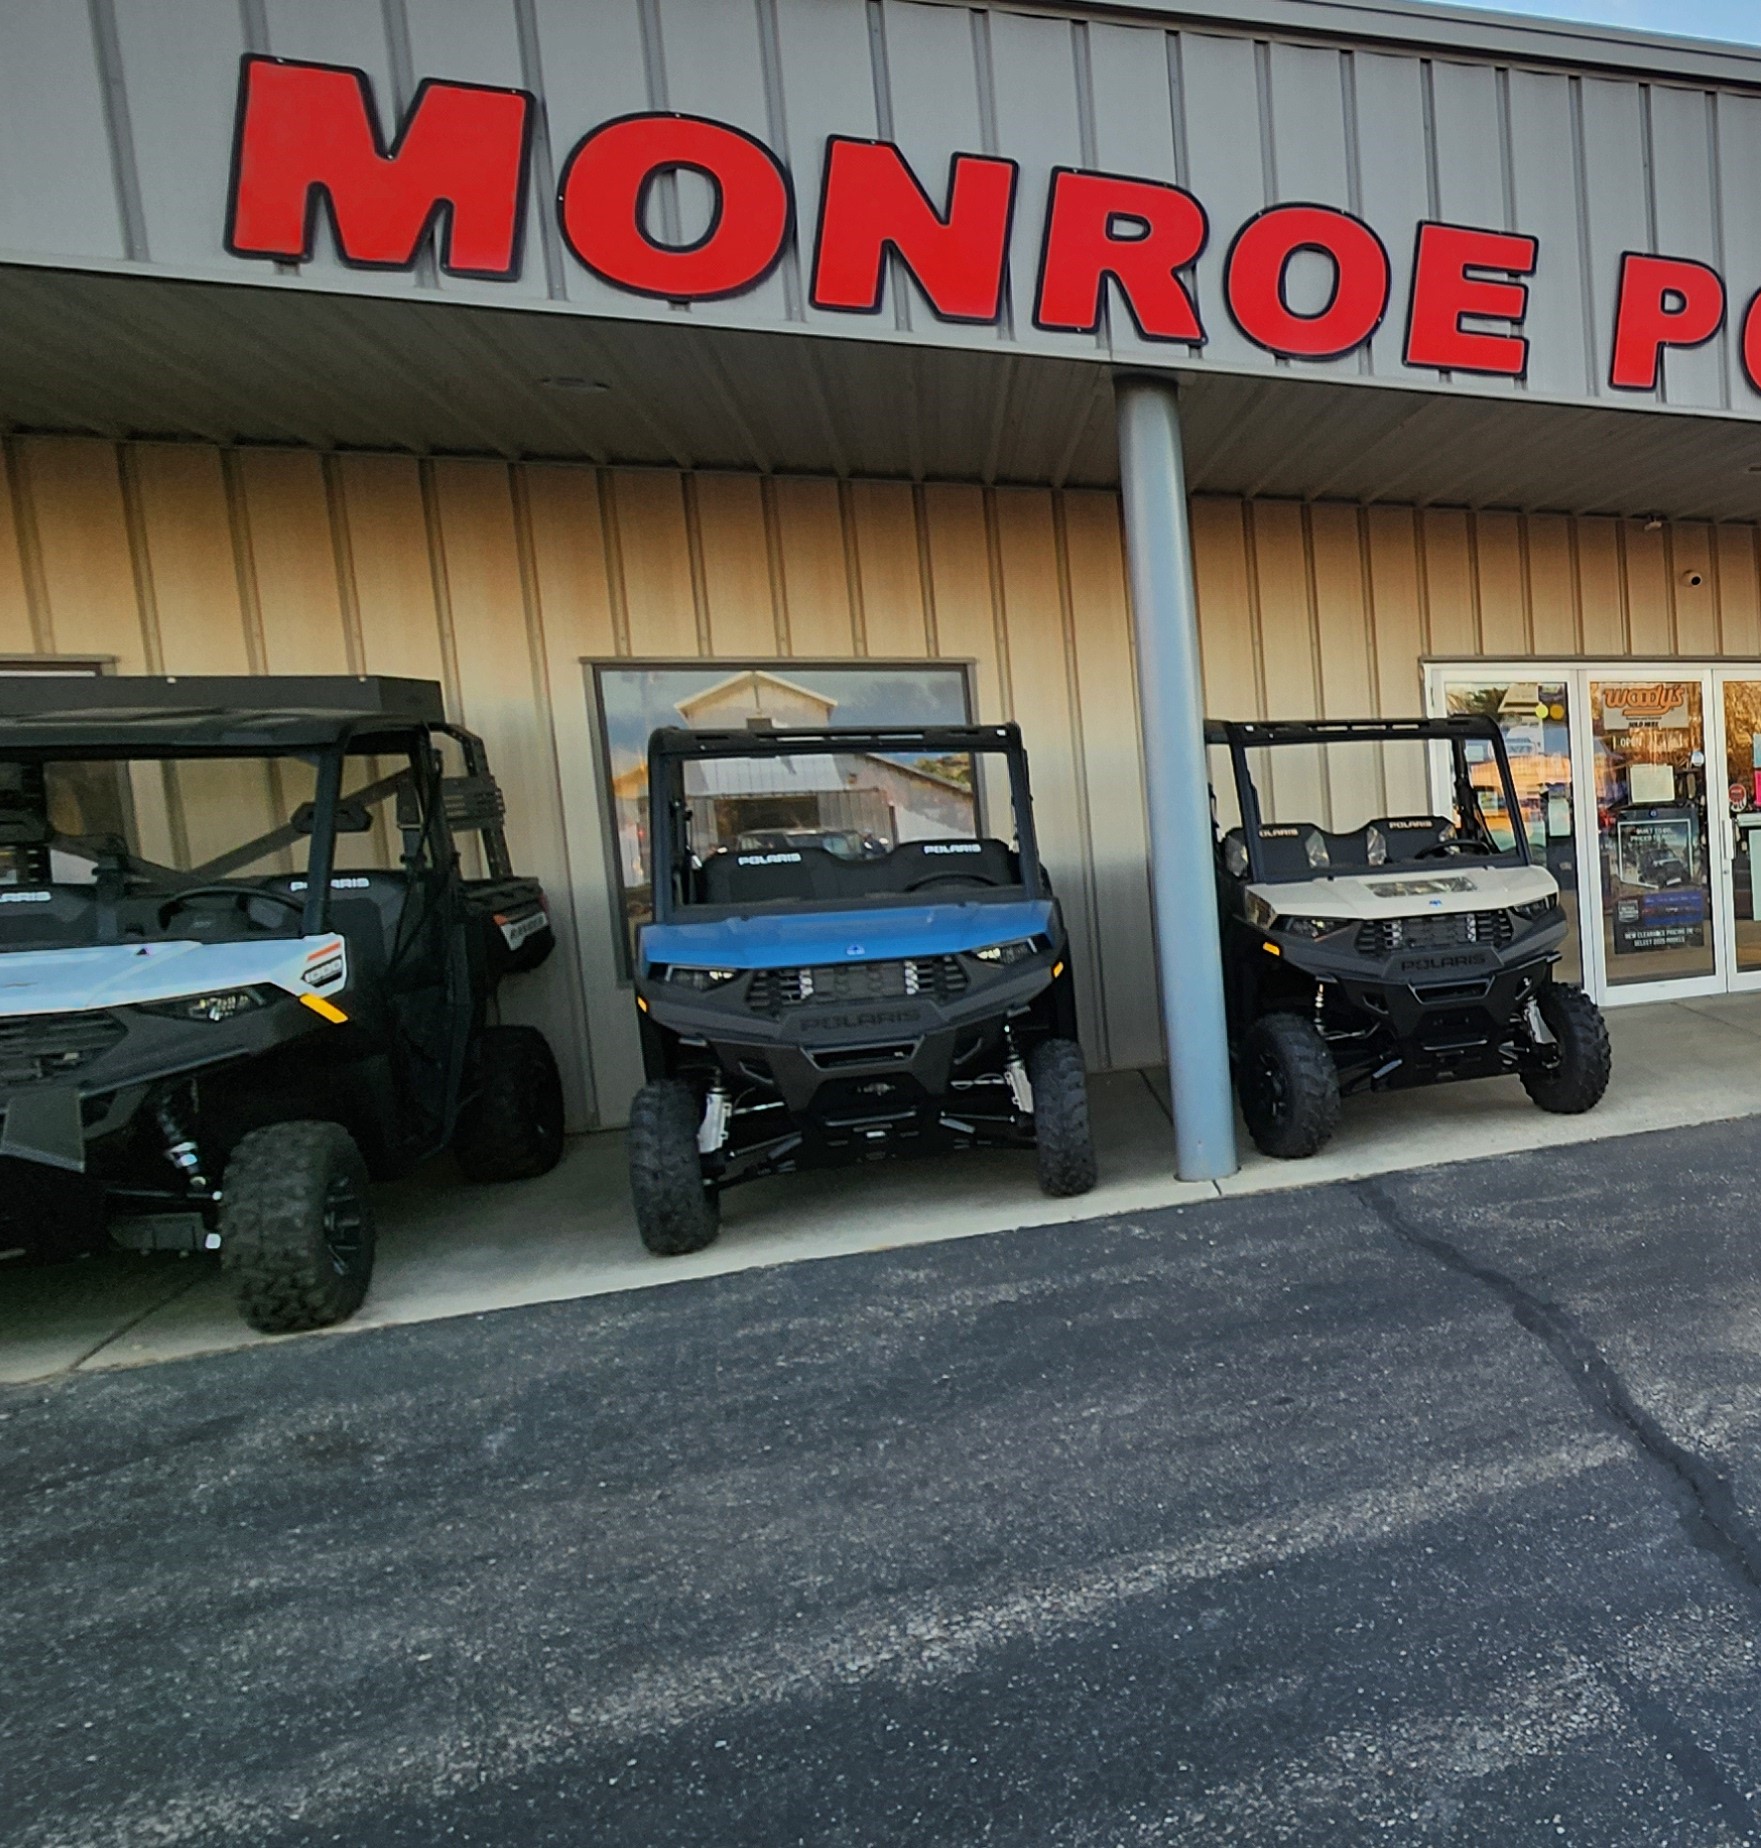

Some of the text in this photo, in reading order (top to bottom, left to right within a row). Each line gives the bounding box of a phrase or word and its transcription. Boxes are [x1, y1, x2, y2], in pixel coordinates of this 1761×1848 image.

[223, 53, 1539, 377] MONROE
[1389, 820, 1433, 829] POLARIS
[1258, 828, 1299, 838] OLARIS
[924, 844, 982, 855] POLARIS
[738, 853, 802, 866] POLARIS
[290, 878, 369, 892] PARIS
[1401, 953, 1486, 972] POLARIS
[800, 1008, 921, 1032] POLARIS
